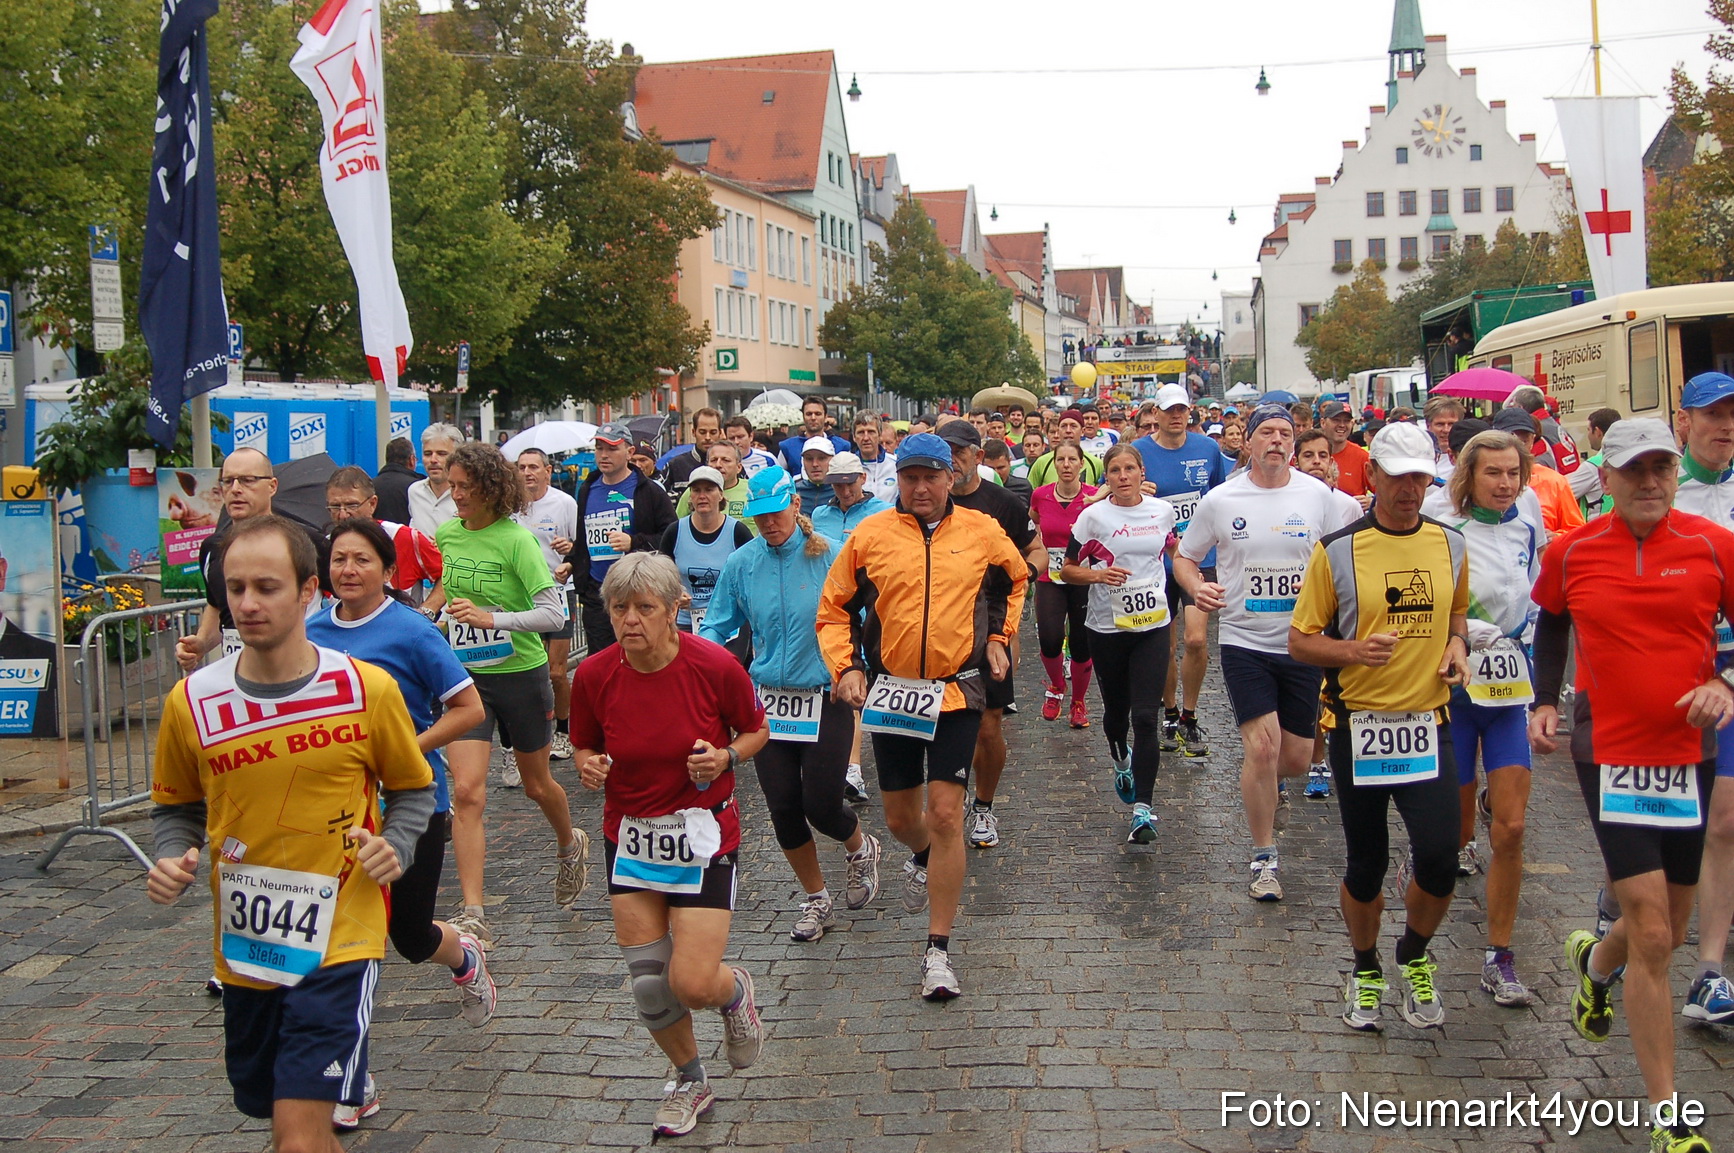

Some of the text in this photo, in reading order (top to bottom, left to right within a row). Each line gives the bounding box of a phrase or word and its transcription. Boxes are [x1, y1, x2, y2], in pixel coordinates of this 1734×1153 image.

[230, 328, 240, 356] P
[460, 347, 468, 369] P
[1552, 341, 1602, 371] Bayerisches
[1124, 363, 1156, 373] START
[1552, 373, 1575, 392] Rotes
[1555, 396, 1575, 415] reuz
[390, 416, 412, 434] IXI
[588, 527, 618, 545] 286
[168, 541, 191, 553] BEIDE
[1267, 565, 1297, 573] Neumarkt
[1109, 583, 1153, 595] PARTL Neumarkt
[1121, 591, 1157, 614] 386
[1132, 615, 1153, 626] Heike
[1387, 613, 1432, 625] HIRSCH
[465, 649, 497, 660] Daniela
[0, 668, 26, 679] CSU
[1478, 654, 1519, 680] 430
[1489, 686, 1513, 697] Berta
[0, 700, 29, 720] ER
[764, 693, 814, 718] 2601
[872, 687, 935, 718] 2602
[775, 722, 797, 733] Petra
[881, 715, 917, 728] Werner
[1352, 715, 1421, 725] PARTL Neumarkt
[207, 723, 369, 776] MAX BÖGL
[1360, 725, 1430, 756] 2908
[1381, 762, 1411, 773] Franz
[1611, 764, 1688, 794] 2094
[1634, 799, 1665, 814] Erich
[645, 820, 686, 830] Neumarkt
[626, 826, 695, 864] 3190
[221, 872, 315, 896] PARTL Neumarkt
[230, 890, 320, 943] 3044
[248, 943, 286, 967] Stefan
